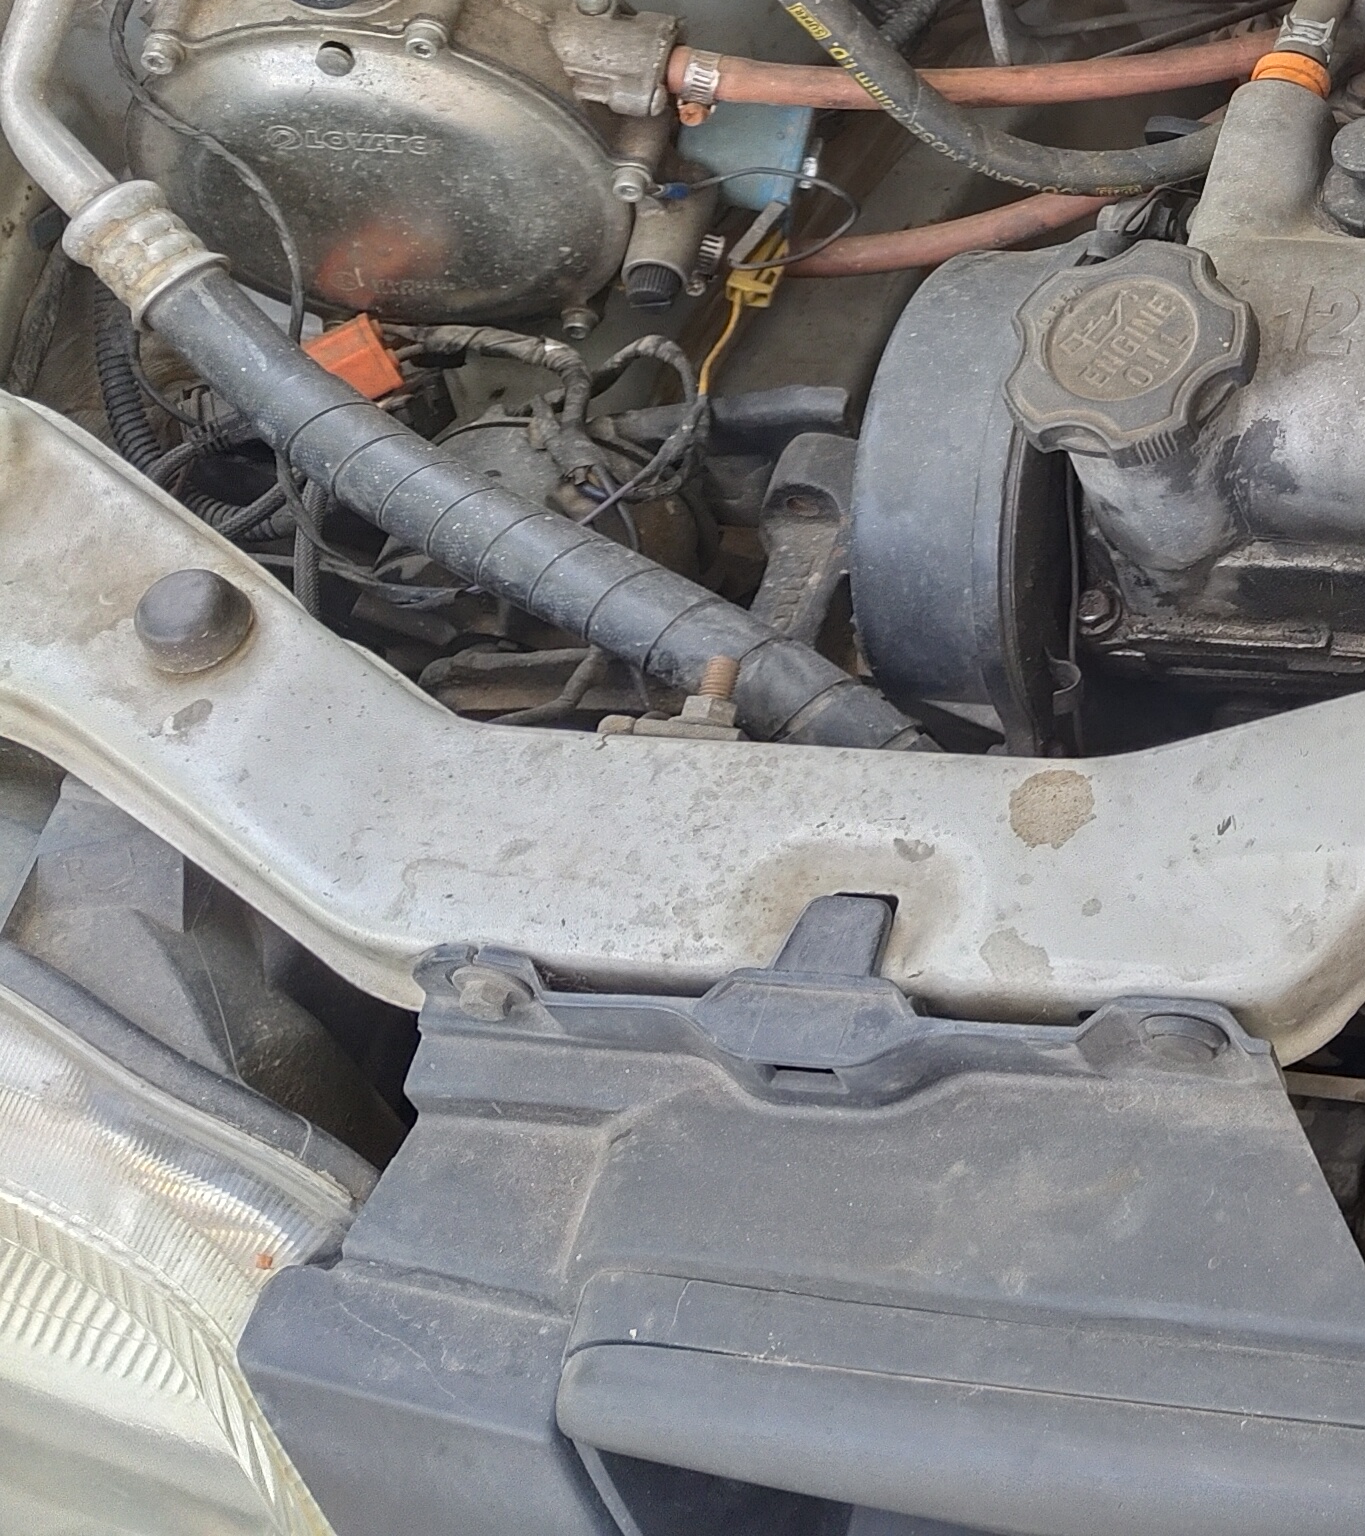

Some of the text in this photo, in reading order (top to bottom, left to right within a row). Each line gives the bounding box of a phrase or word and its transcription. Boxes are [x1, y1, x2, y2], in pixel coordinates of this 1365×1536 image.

[794, 6, 829, 38] SUPER
[1079, 290, 1177, 389] ENGINE
[1273, 285, 1362, 356] 12
[1122, 331, 1192, 389] OIL
